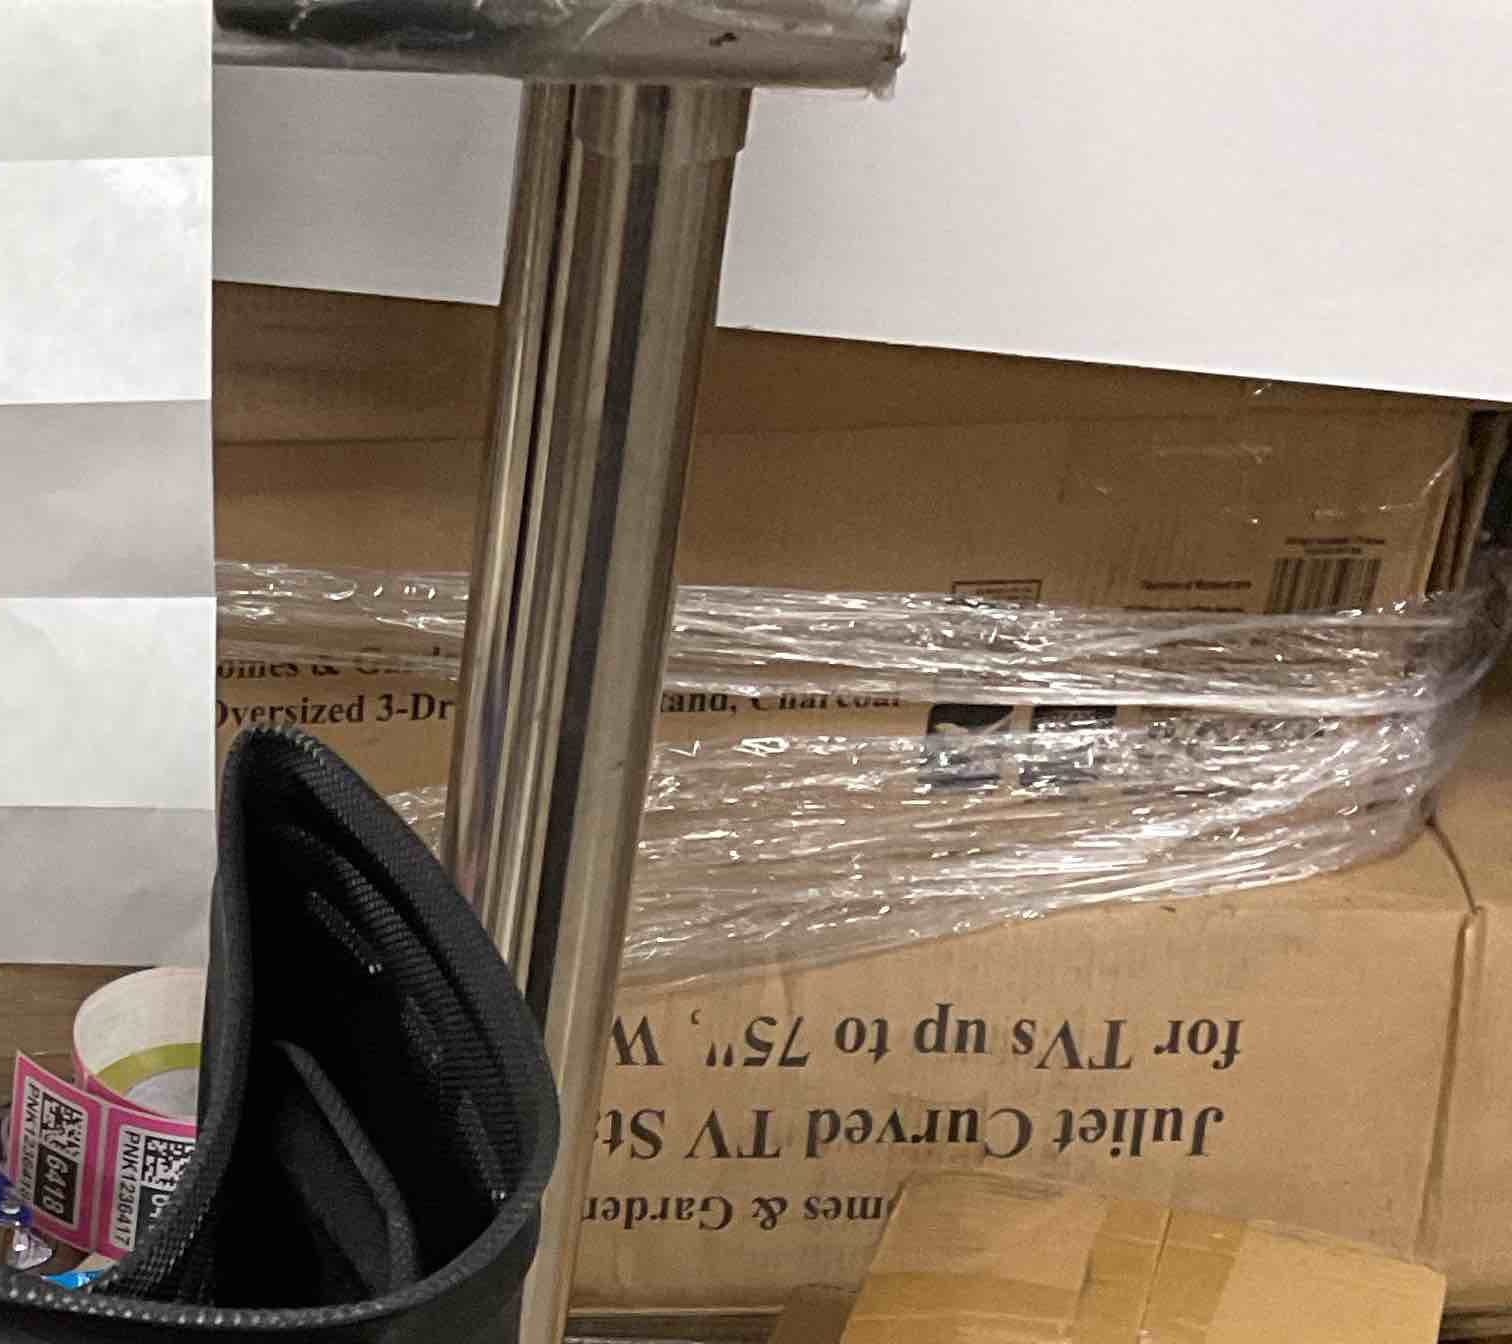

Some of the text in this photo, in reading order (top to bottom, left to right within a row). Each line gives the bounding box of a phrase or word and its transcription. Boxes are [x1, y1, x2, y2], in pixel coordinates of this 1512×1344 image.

[834, 1016, 890, 1064] to
[913, 1002, 988, 1054] up
[1011, 1018, 1133, 1070] TVs
[1153, 1018, 1244, 1069] for
[683, 1109, 781, 1159] TV
[804, 1107, 1032, 1160] Curved
[1051, 1106, 1224, 1157] Juliet
[111, 1129, 142, 1247] PNK1236417
[751, 1195, 790, 1231] &
[803, 1195, 896, 1220] mes
